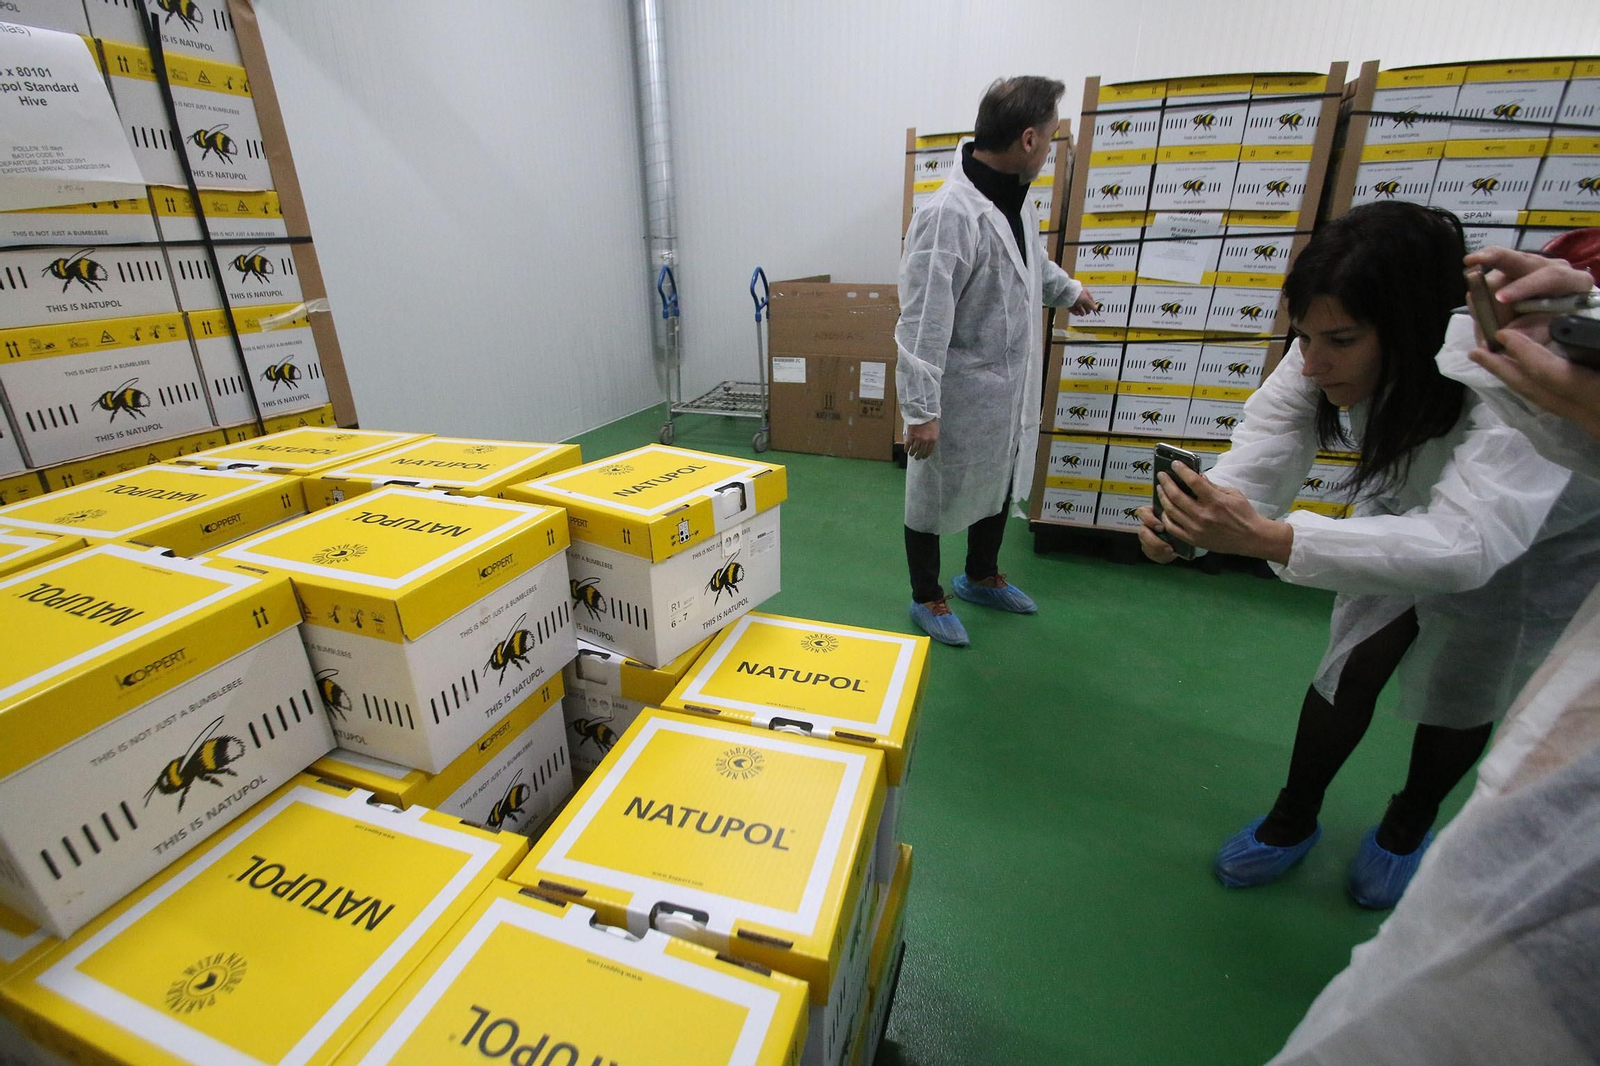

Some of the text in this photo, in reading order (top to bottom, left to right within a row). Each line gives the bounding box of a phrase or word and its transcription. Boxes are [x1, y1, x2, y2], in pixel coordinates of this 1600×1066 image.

[170, 36, 178, 44] IS
[180, 38, 215, 52] NATUPOL
[16, 66, 52, 78] 80101
[24, 81, 80, 92] Standard
[18, 96, 48, 106] Hive
[216, 172, 248, 180] NATUPOL
[1463, 211, 1492, 220] SPAIN
[230, 292, 246, 300] THIS
[254, 290, 284, 299] NATUPOL
[46, 300, 122, 314] THIS IS NATUPOL
[119, 360, 150, 369] BUMBLEBEE
[283, 394, 310, 404] NATUPOL
[95, 422, 164, 443] THIS IS NATUPOL
[250, 444, 337, 456] NATUPOL
[390, 457, 490, 470] NATUPOL
[613, 463, 707, 498] NATUPOL
[105, 484, 208, 502] NATUPOL
[352, 511, 472, 537] NATUPOL
[692, 552, 702, 560] THIS
[706, 544, 716, 554] NOT
[586, 556, 613, 570] BUMBLEBEE
[20, 582, 145, 627] NATUPOL
[460, 626, 473, 640] THIS
[474, 622, 479, 630] IS
[480, 614, 492, 628] NOT
[492, 606, 504, 619] JUST
[510, 584, 538, 606] BUMBLEBEE
[671, 612, 688, 628] 6 7
[702, 596, 750, 631] THIS IS NATUPOL
[584, 625, 616, 642] NATUPOL
[736, 660, 866, 693] NATUPOL
[485, 700, 503, 718] THIS
[504, 692, 512, 704] IS
[512, 666, 545, 696] NATUPOL
[90, 750, 116, 767] THIS
[117, 742, 128, 752] IS
[130, 728, 152, 746] NOT
[155, 714, 177, 732] JUST
[180, 710, 188, 718] A
[188, 678, 244, 713] BUMBLEBEE
[460, 796, 473, 810] THIS
[472, 791, 478, 799] IS
[478, 780, 490, 794] NOT
[490, 768, 502, 783] JUST
[507, 740, 534, 768] BUMBLEBEE
[152, 775, 268, 855] THIS IS NATUPOL
[622, 796, 790, 851] NATUPOL
[236, 854, 396, 932] NATUPOL
